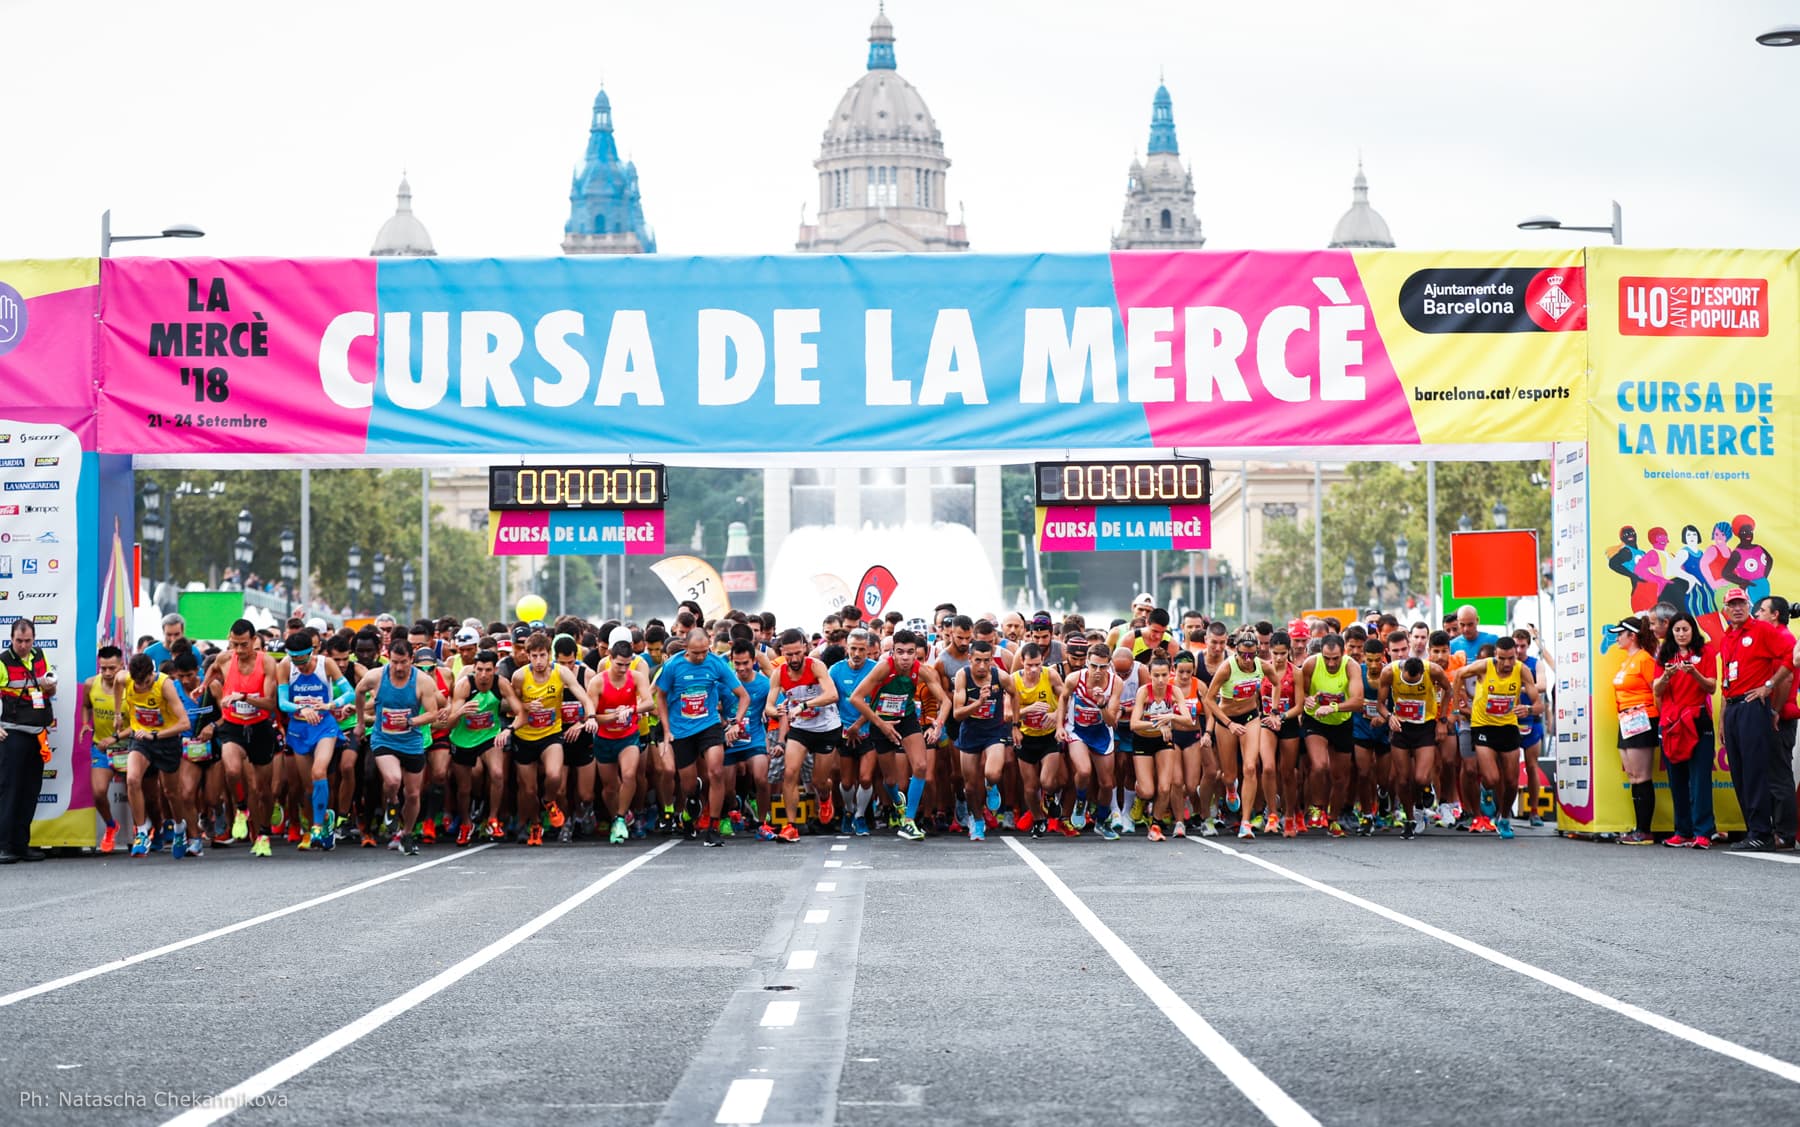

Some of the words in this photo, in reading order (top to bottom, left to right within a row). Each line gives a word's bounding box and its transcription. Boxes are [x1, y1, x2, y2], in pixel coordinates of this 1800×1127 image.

[188, 278, 230, 312] LA
[1424, 284, 1496, 297] Ajuntament
[1498, 283, 1514, 295] de
[1691, 287, 1760, 306] D'ESPORT
[1424, 299, 1514, 315] Barcelona
[1627, 286, 1668, 328] 40
[1670, 287, 1688, 328] ANYS
[1691, 309, 1760, 329] POPULAR
[149, 311, 268, 357] MERCÈ
[319, 310, 665, 412] CURSA
[698, 309, 820, 406] DE
[865, 309, 988, 406] LA
[1020, 277, 1366, 404] MERCÈ
[180, 367, 229, 403] '18
[1415, 386, 1570, 402] barcelona.cat/esports
[1617, 381, 1725, 413] CURSA
[1735, 382, 1773, 414] DE
[147, 414, 162, 428] 21
[175, 414, 192, 428] 24
[197, 413, 268, 428] Setembre
[1618, 423, 1656, 455] LA
[1666, 415, 1775, 456] MERCÈ
[516, 469, 656, 504] 00:00:00
[1063, 465, 1202, 500] 00:00:00
[1643, 468, 1750, 481] barcelona.cat/esports
[499, 526, 551, 543] CURSA
[554, 526, 575, 542] DE
[579, 526, 599, 542] LA
[601, 521, 655, 542] MERCÈ
[1046, 521, 1098, 538] CURSA
[1101, 521, 1121, 537] DE
[1126, 521, 1145, 537] LA
[1149, 516, 1202, 537] MERCÈ
